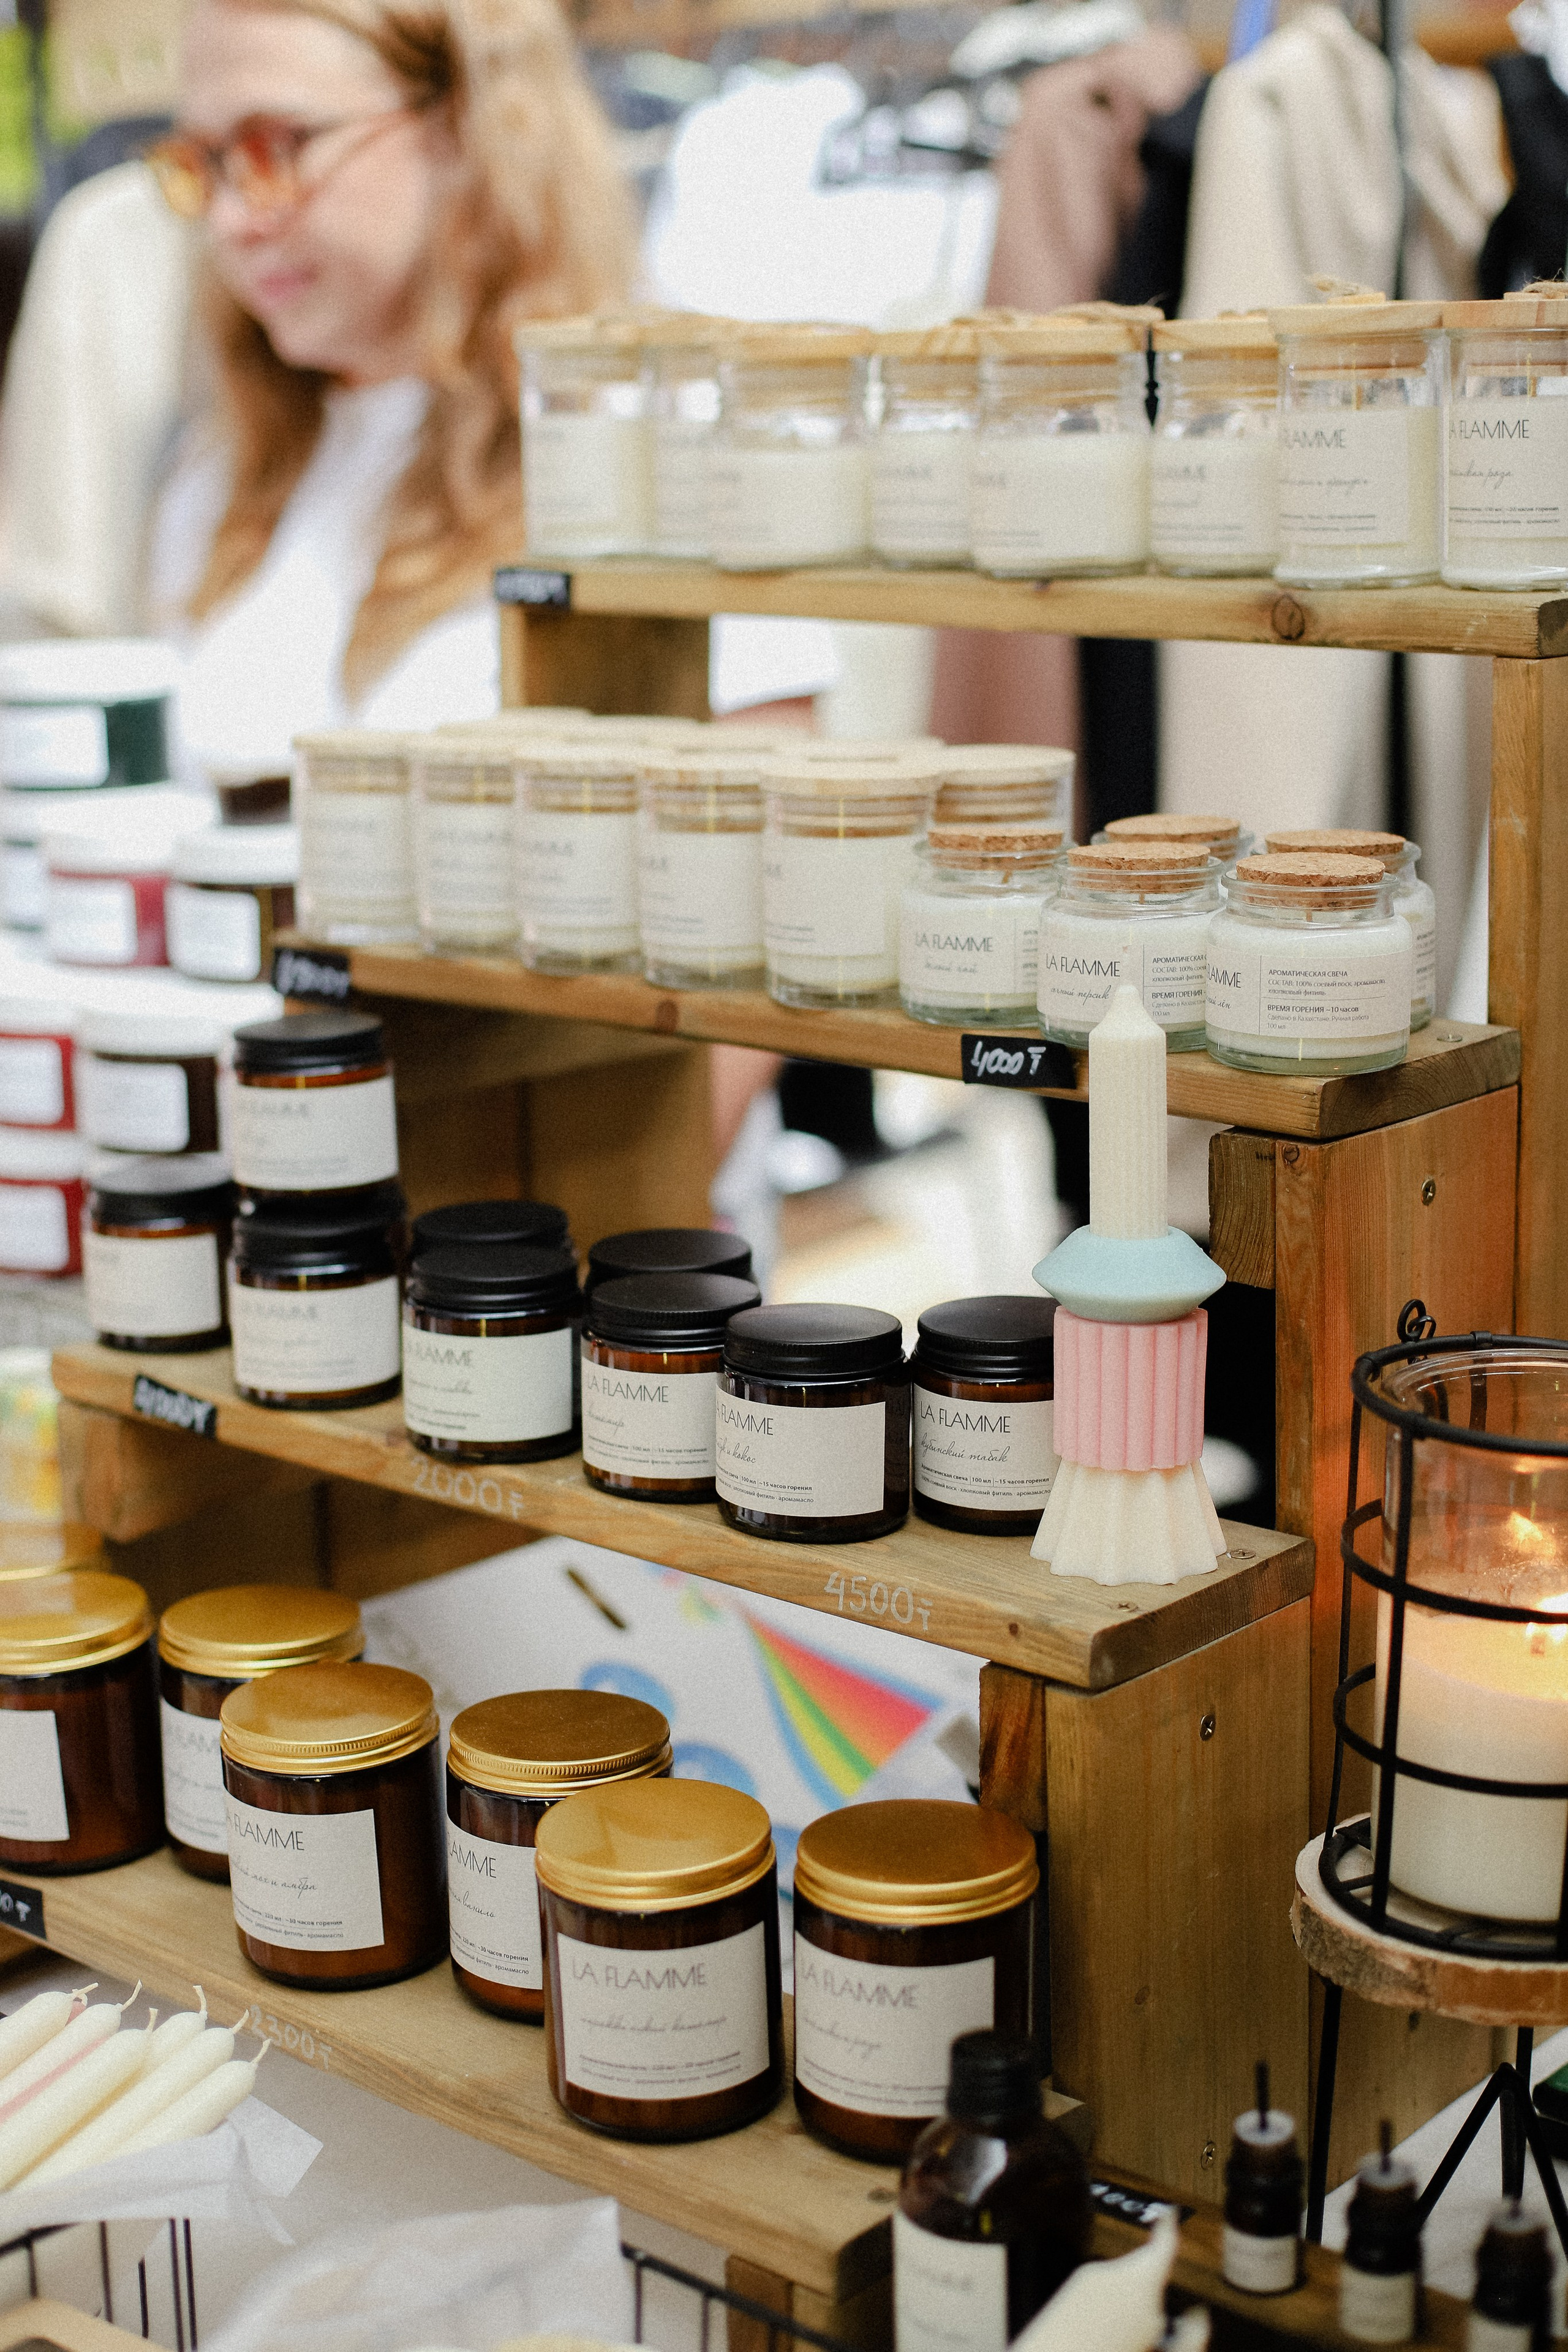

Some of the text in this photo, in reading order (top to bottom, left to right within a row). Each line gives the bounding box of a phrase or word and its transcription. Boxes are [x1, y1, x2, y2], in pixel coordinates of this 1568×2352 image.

[1460, 420, 1530, 440] FLAMME
[933, 934, 993, 952] FLAMME
[1046, 952, 1121, 978] LA FLAMME
[1152, 954, 1204, 964] АРОМАТИЧЕСКАЯ
[1268, 969, 1326, 978] АРОМАТИЧЕСКАЯ
[1077, 984, 1112, 1006] персик
[1175, 989, 1202, 998] ГОРЕНИЯ
[1267, 1013, 1292, 1022] Сделано
[1352, 1014, 1370, 1022] работа
[603, 1378, 669, 1403] FLAMME
[721, 1403, 774, 1436] FLAMME
[921, 1400, 1011, 1434] LA FLAMME
[732, 1442, 757, 1463] кокос
[920, 1432, 1011, 1463] кубинский табак
[921, 1463, 953, 1479] Ароматическая
[1016, 1489, 1051, 1498] аромамасло
[234, 1812, 305, 1851] FLAMME
[449, 1838, 497, 1879] AMME
[487, 1948, 503, 1958] часов
[503, 1952, 529, 1962] горения
[494, 1964, 529, 1975] аромамасло
[572, 1958, 707, 1991] LA FLAMME
